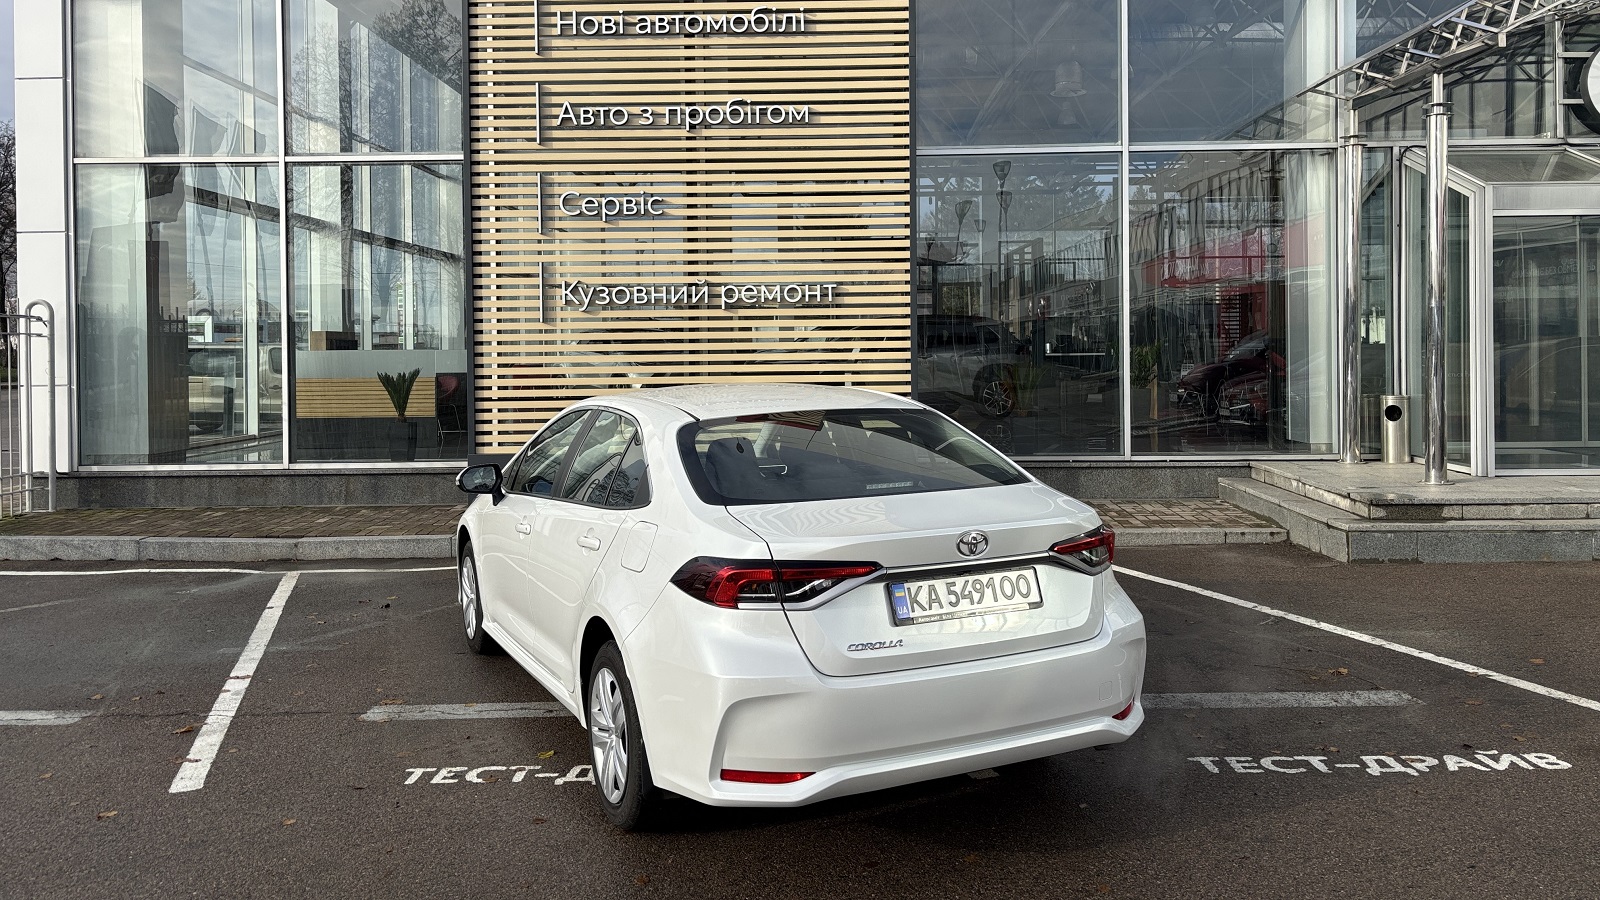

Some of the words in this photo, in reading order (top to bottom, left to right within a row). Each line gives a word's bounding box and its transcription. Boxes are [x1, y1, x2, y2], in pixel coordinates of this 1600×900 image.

[556, 8, 625, 36] Нові
[635, 6, 806, 35] автомобілі
[556, 101, 628, 126] Авто
[638, 105, 654, 126] з
[665, 99, 810, 131] пробігом
[559, 191, 664, 222] Сервіс
[561, 279, 709, 312] Кузовний
[720, 282, 837, 310] ремонт
[897, 605, 909, 614] UA
[847, 639, 903, 651] COROLLA
[1187, 749, 1573, 776] ТЕСТ-ДРАЙВ
